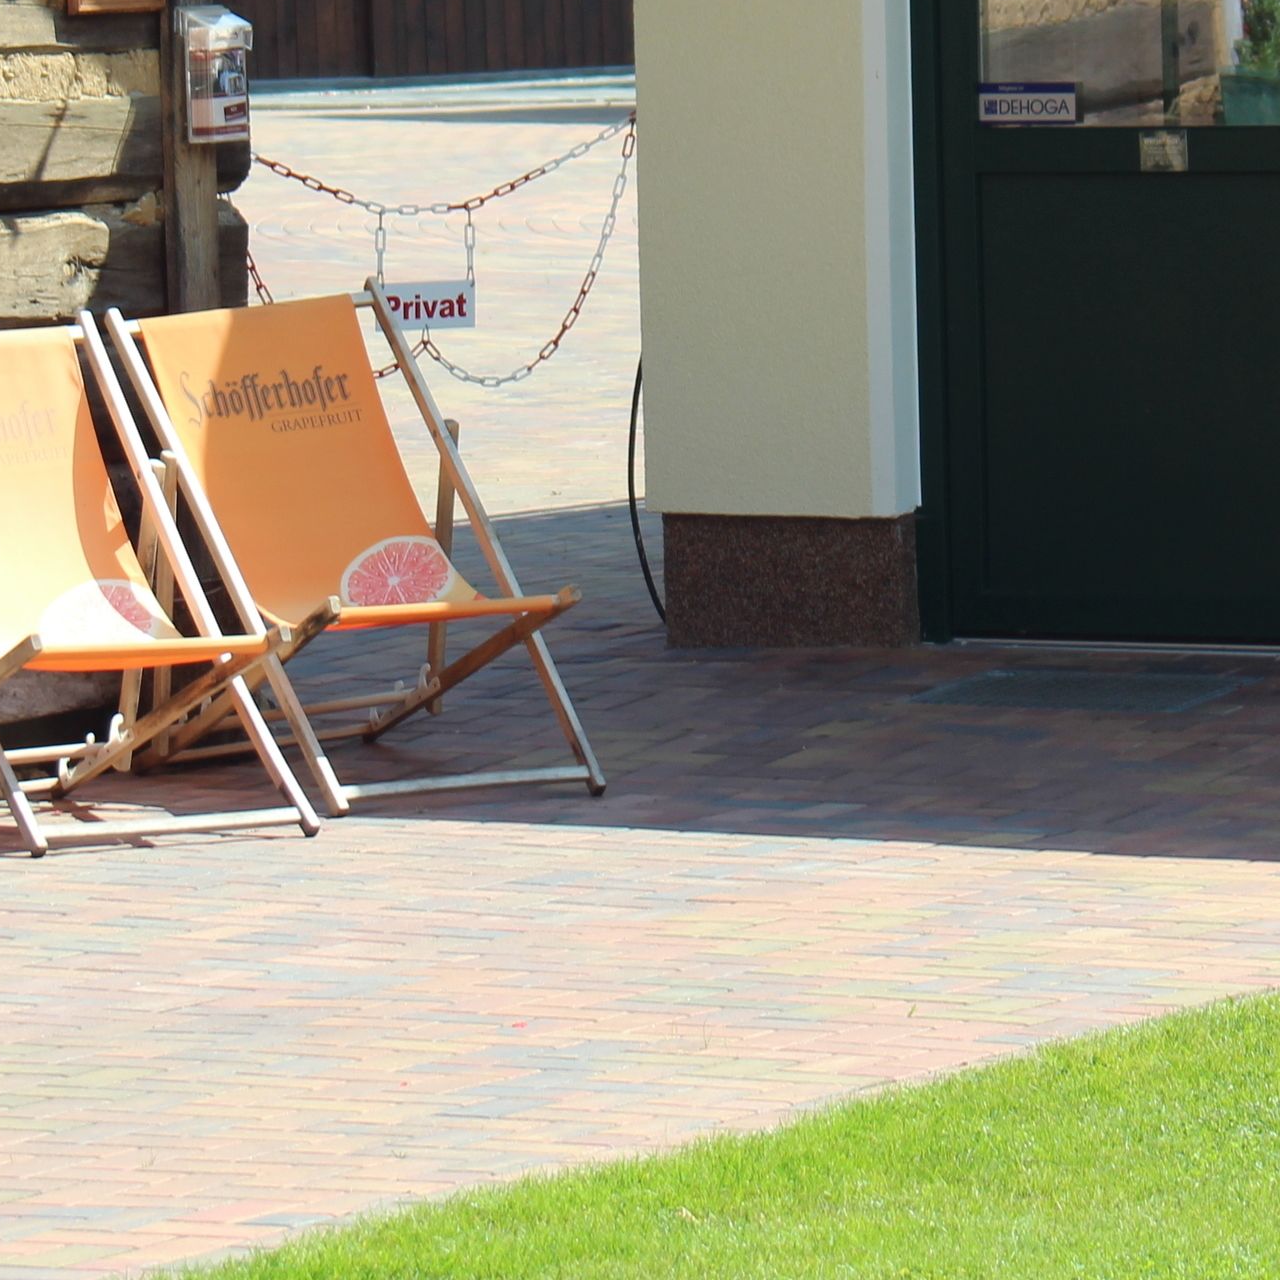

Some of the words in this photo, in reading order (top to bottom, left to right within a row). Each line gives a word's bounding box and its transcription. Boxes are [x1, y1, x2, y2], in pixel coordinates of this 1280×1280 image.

[999, 99, 1070, 115] DEHOGA
[179, 365, 351, 427] Schöfferhofer
[271, 408, 363, 433] GRAPEFRUIT
